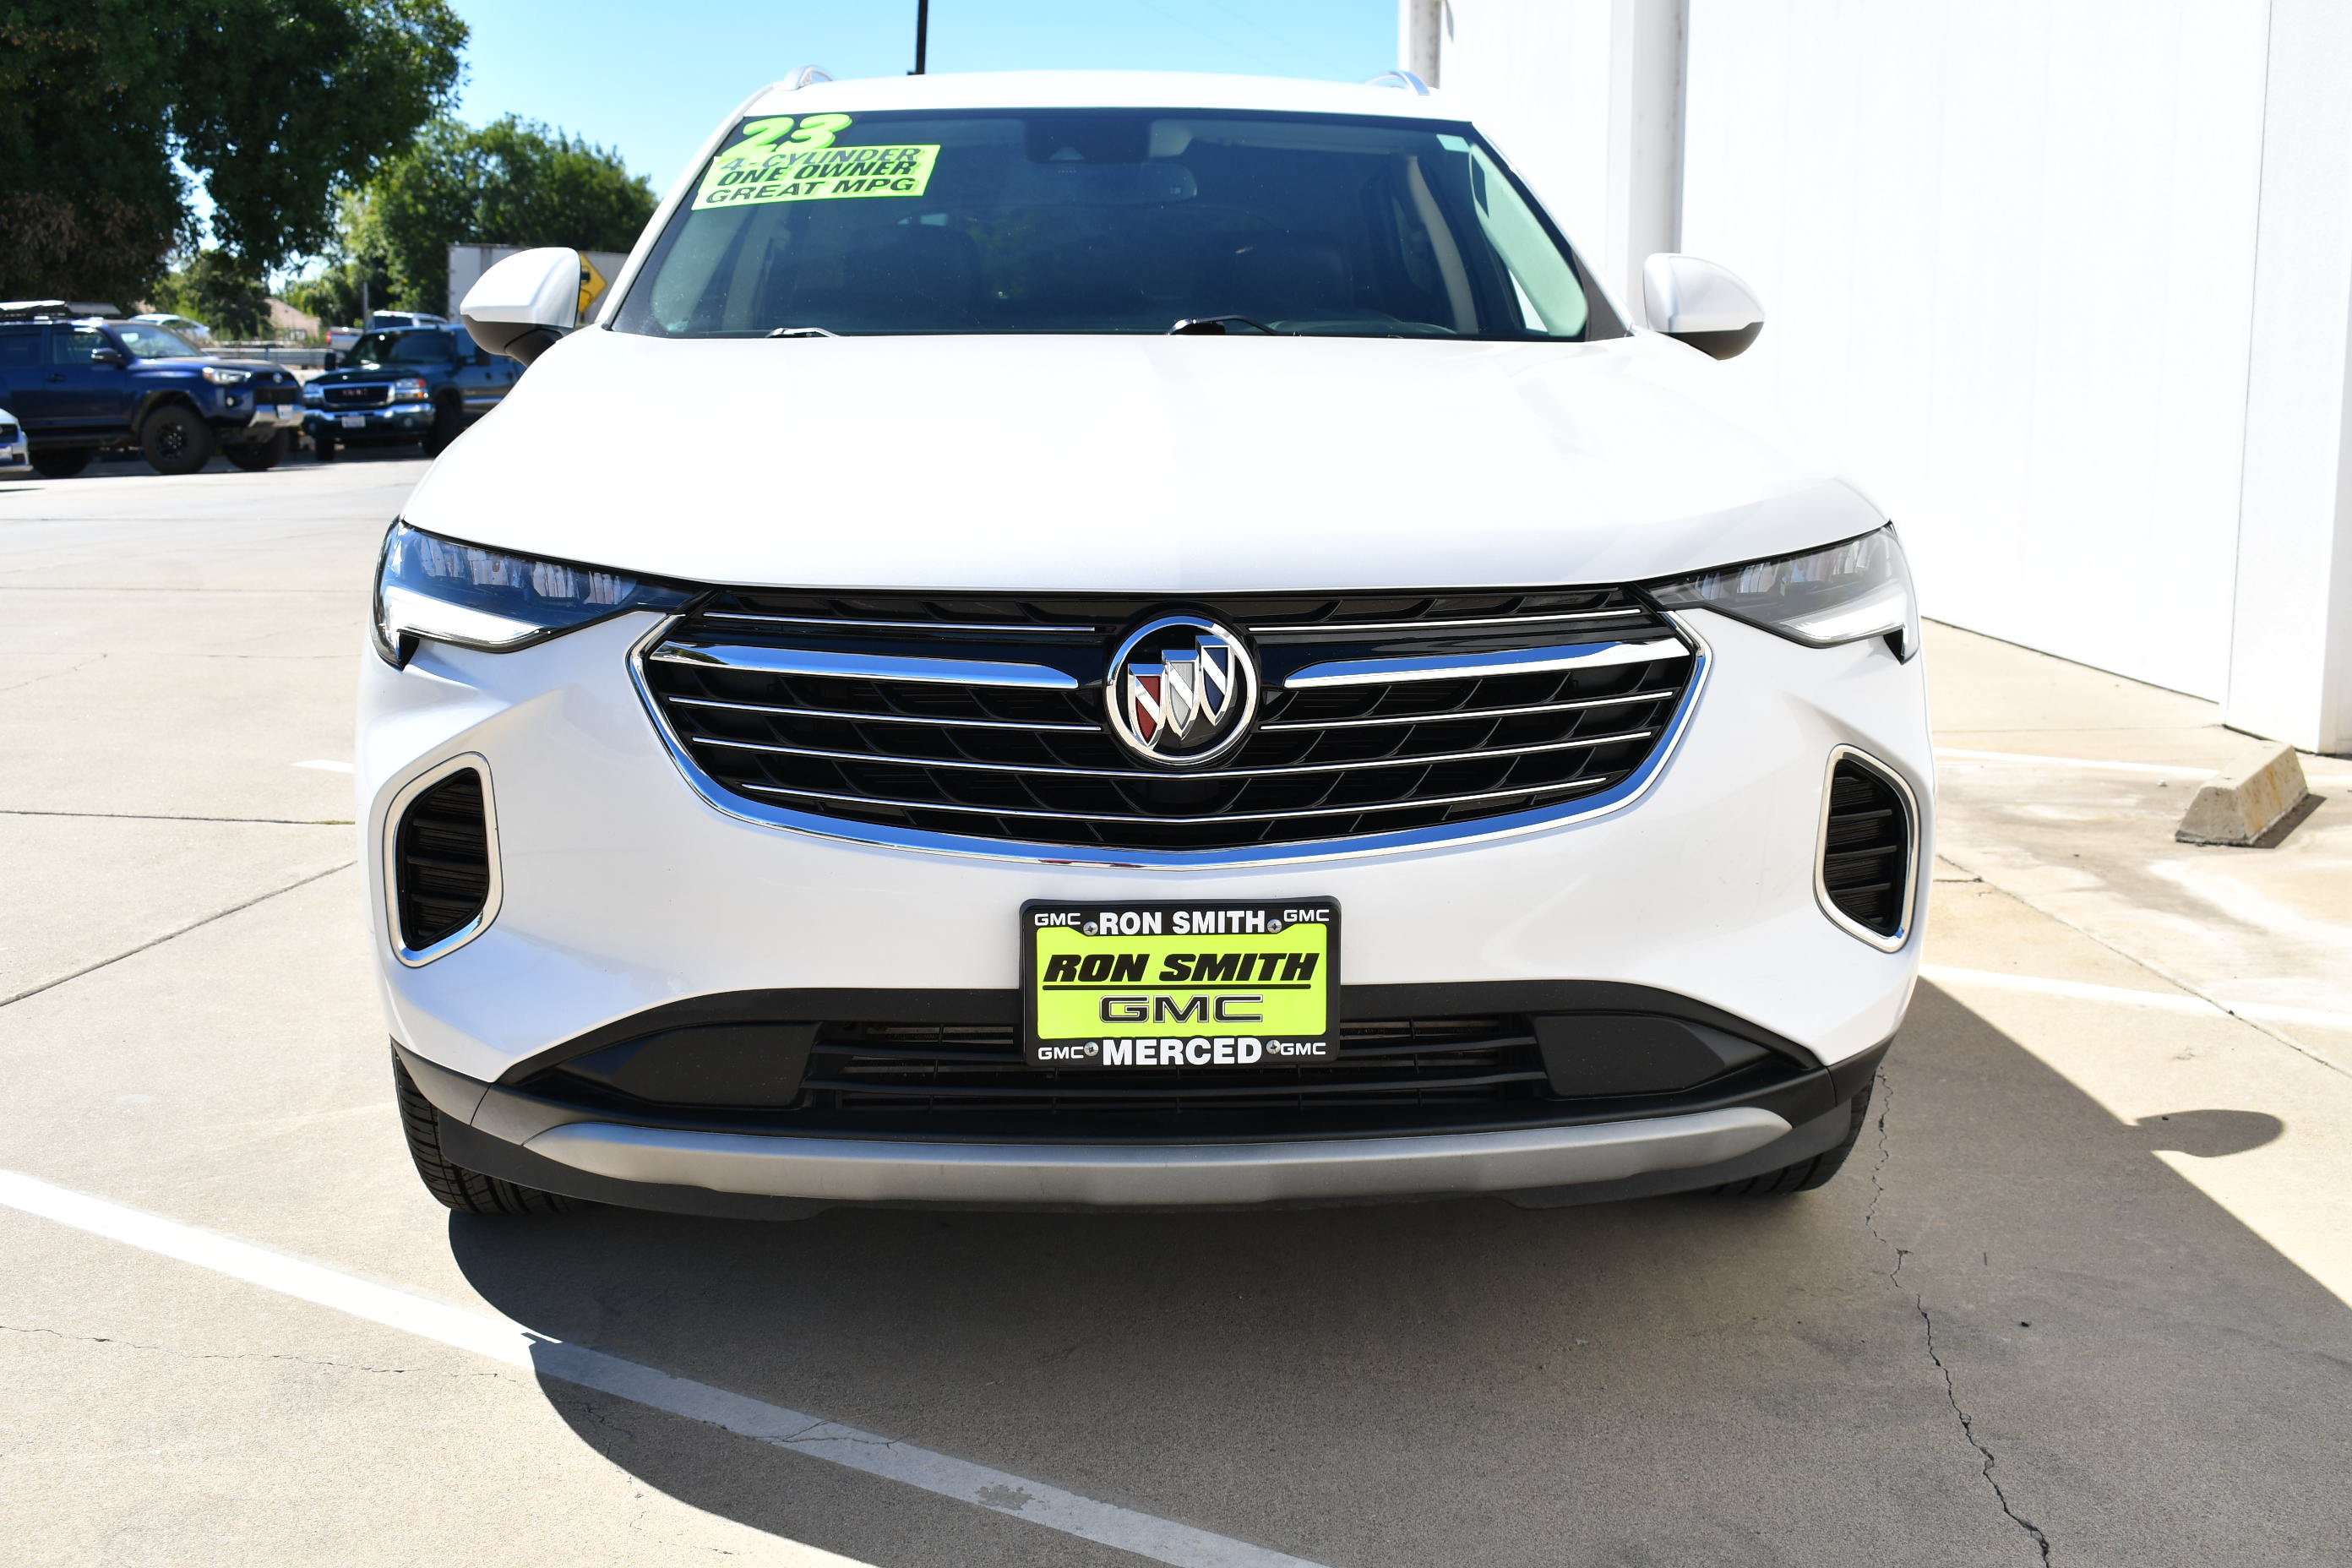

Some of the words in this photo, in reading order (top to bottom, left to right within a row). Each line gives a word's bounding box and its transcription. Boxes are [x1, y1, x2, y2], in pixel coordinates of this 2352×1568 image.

[721, 113, 853, 155] 23
[717, 166, 791, 186] ONE
[793, 161, 917, 178] OWNER
[706, 181, 825, 204] GREAT
[831, 177, 916, 193] MPG
[1034, 912, 1081, 926] GMC
[1099, 912, 1162, 935] RON
[1172, 910, 1266, 934] SMITH
[1283, 909, 1330, 923] GMC
[1043, 953, 1151, 983] RON
[1158, 952, 1320, 982] SMITH
[1099, 994, 1263, 1023] GMC
[1037, 1046, 1084, 1059] GMC
[1102, 1037, 1262, 1065] MERCED
[1280, 1042, 1326, 1056] GMC
